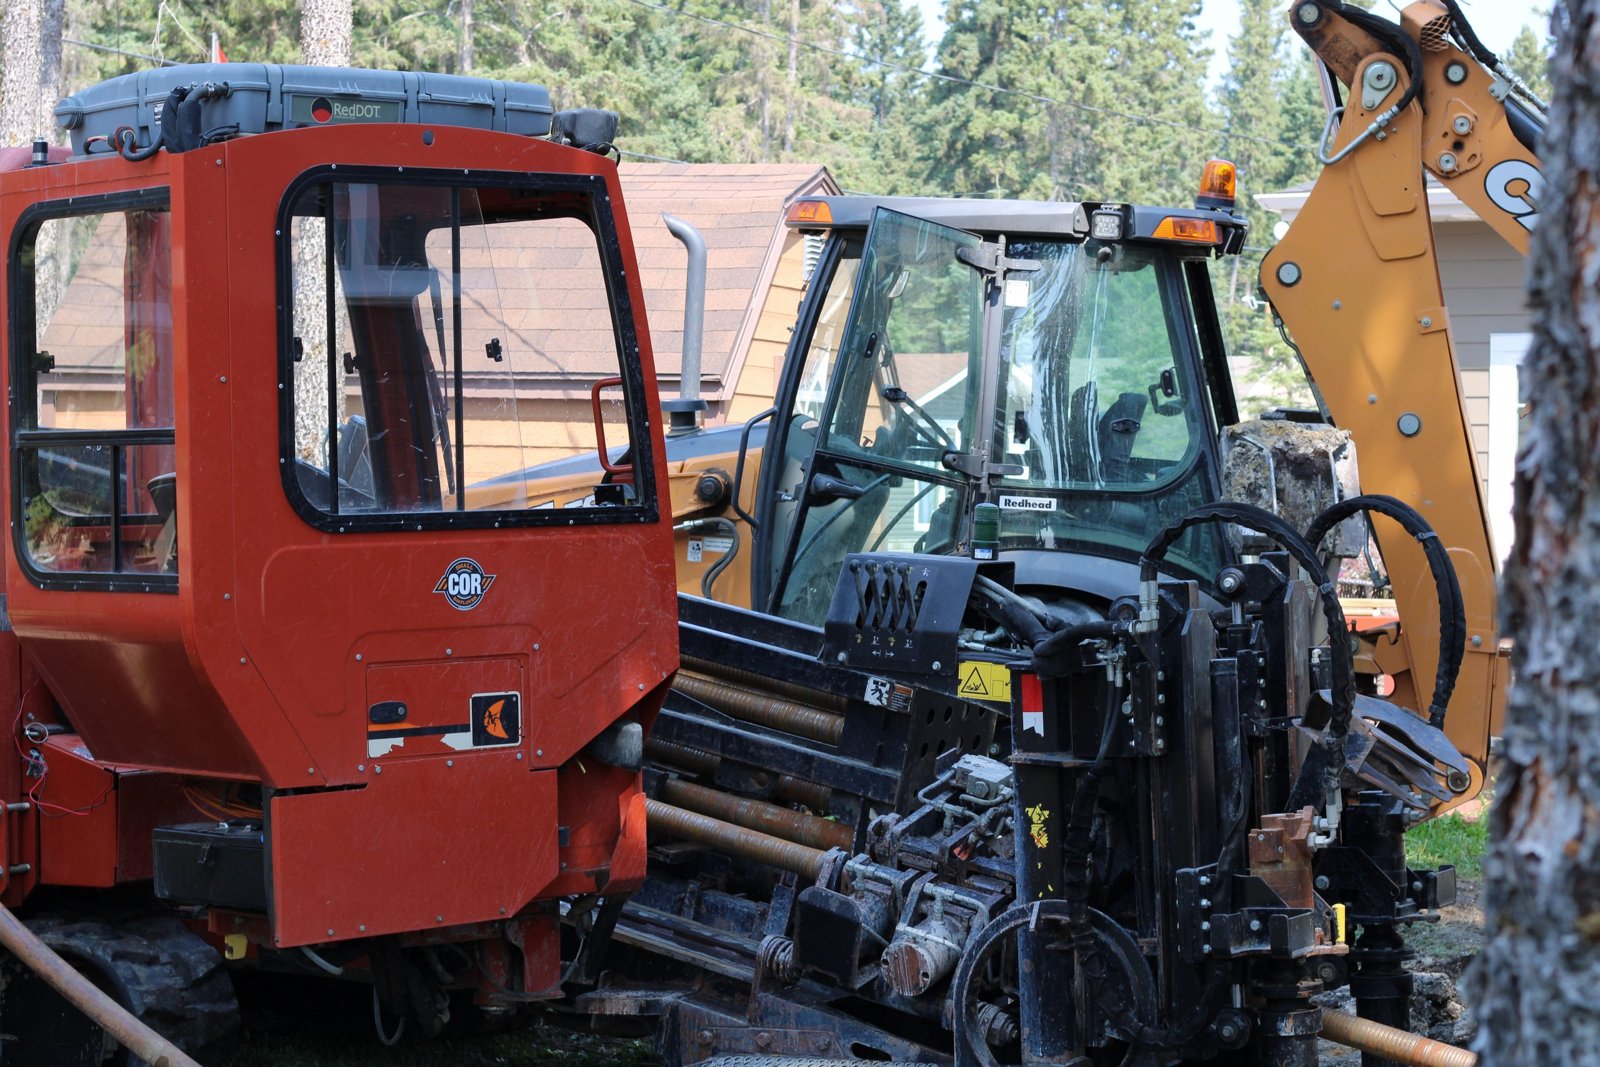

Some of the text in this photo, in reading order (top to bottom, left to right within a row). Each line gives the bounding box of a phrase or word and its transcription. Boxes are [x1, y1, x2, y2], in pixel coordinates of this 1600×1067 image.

[334, 103, 380, 118] RedDOT
[1004, 499, 1052, 509] Redhead
[448, 573, 482, 595] COR
